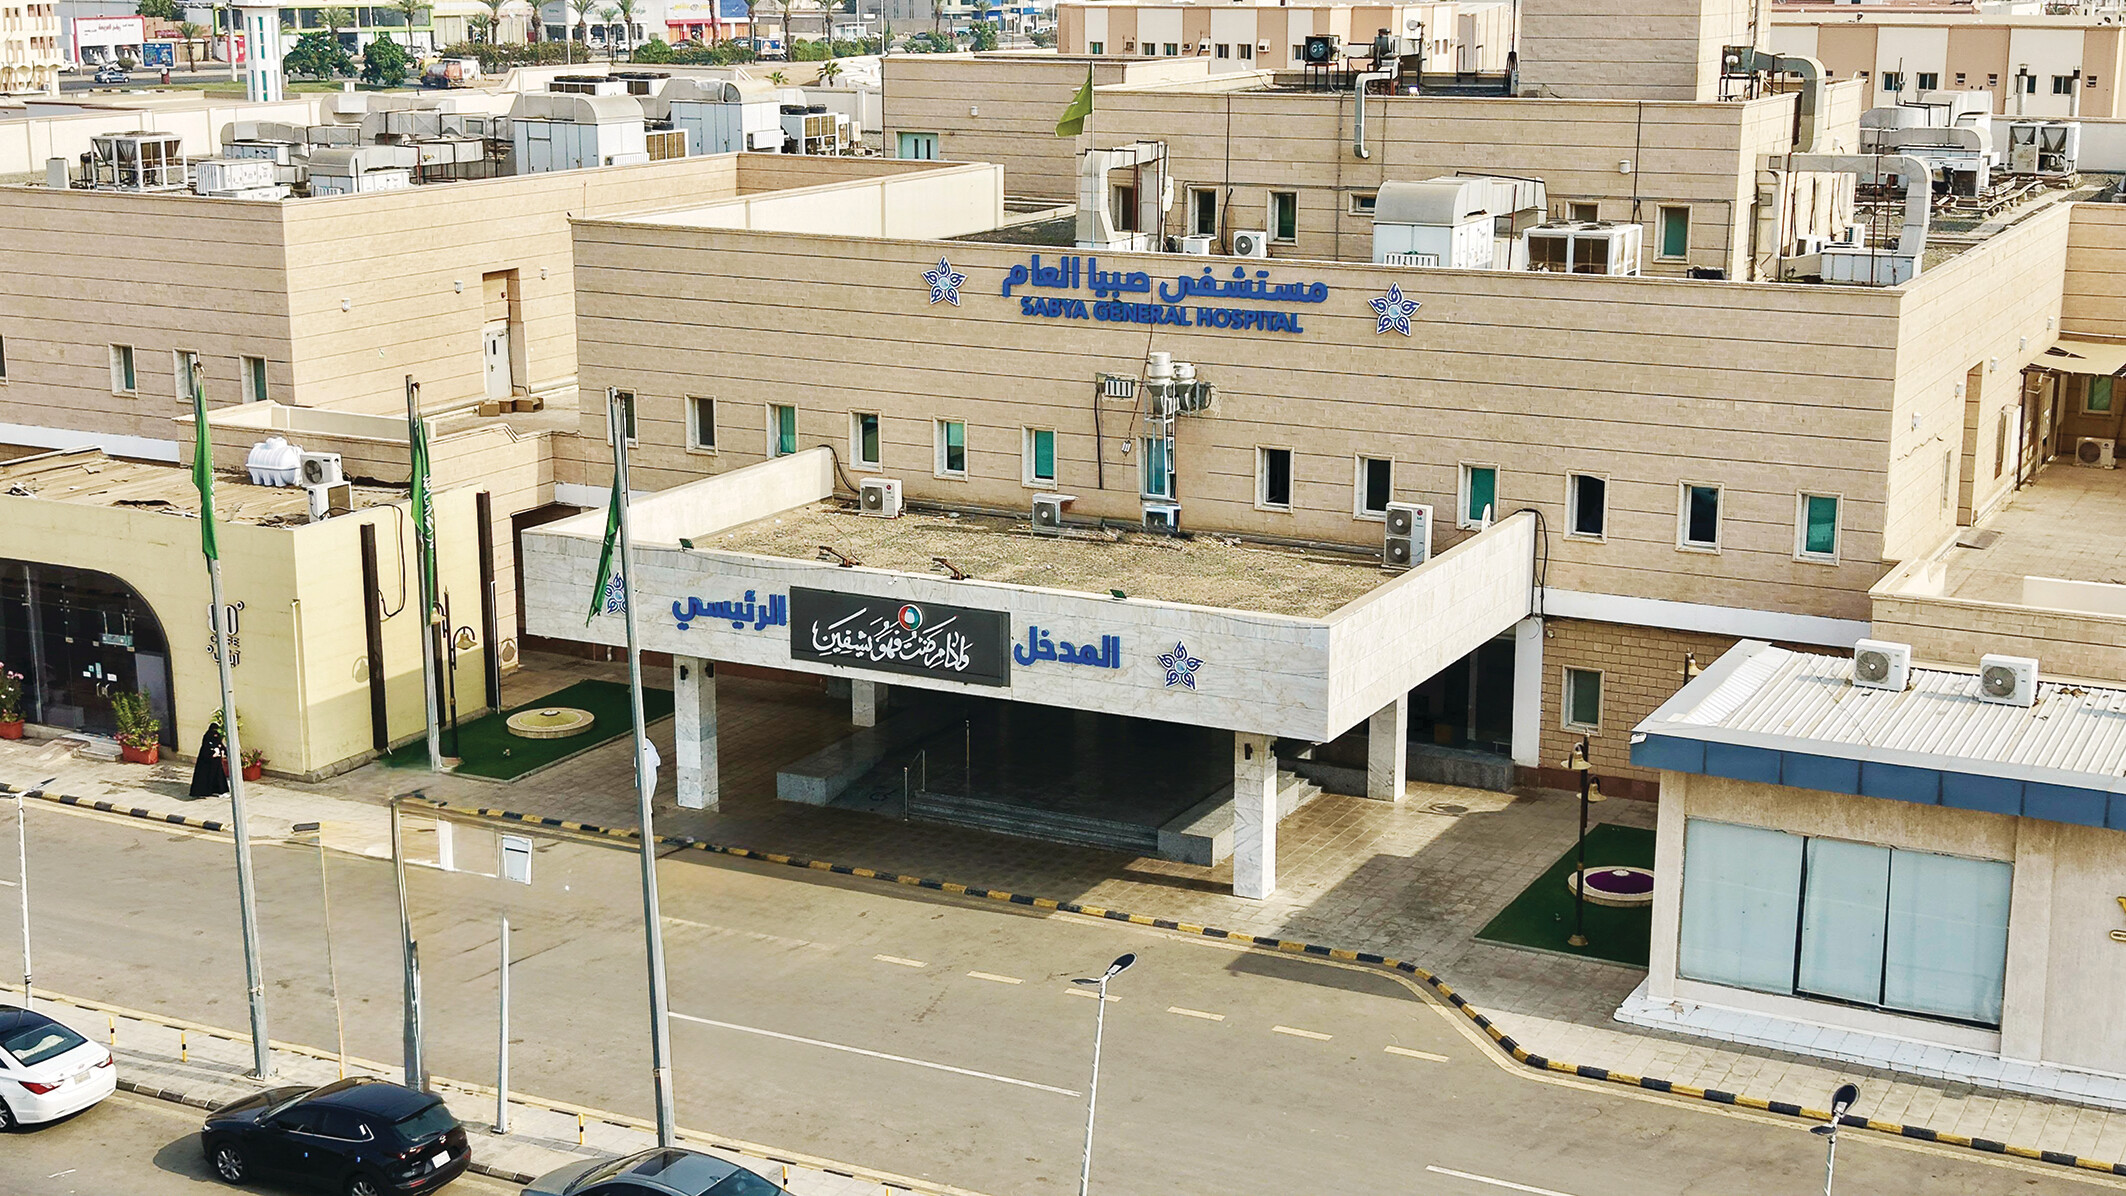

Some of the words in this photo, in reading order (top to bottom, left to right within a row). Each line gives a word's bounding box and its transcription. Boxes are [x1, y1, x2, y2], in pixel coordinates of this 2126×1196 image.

[1002, 254, 1080, 298] العام
[1088, 257, 1150, 299] صبيا
[1159, 266, 1328, 304] مستشفى
[1020, 296, 1089, 320] SABYA
[1093, 300, 1192, 327] GENERAL
[1196, 307, 1304, 334] HOSPITAL
[672, 590, 787, 631] الرئيسي
[210, 634, 240, 648] CFE
[1014, 625, 1121, 669] المدخل
